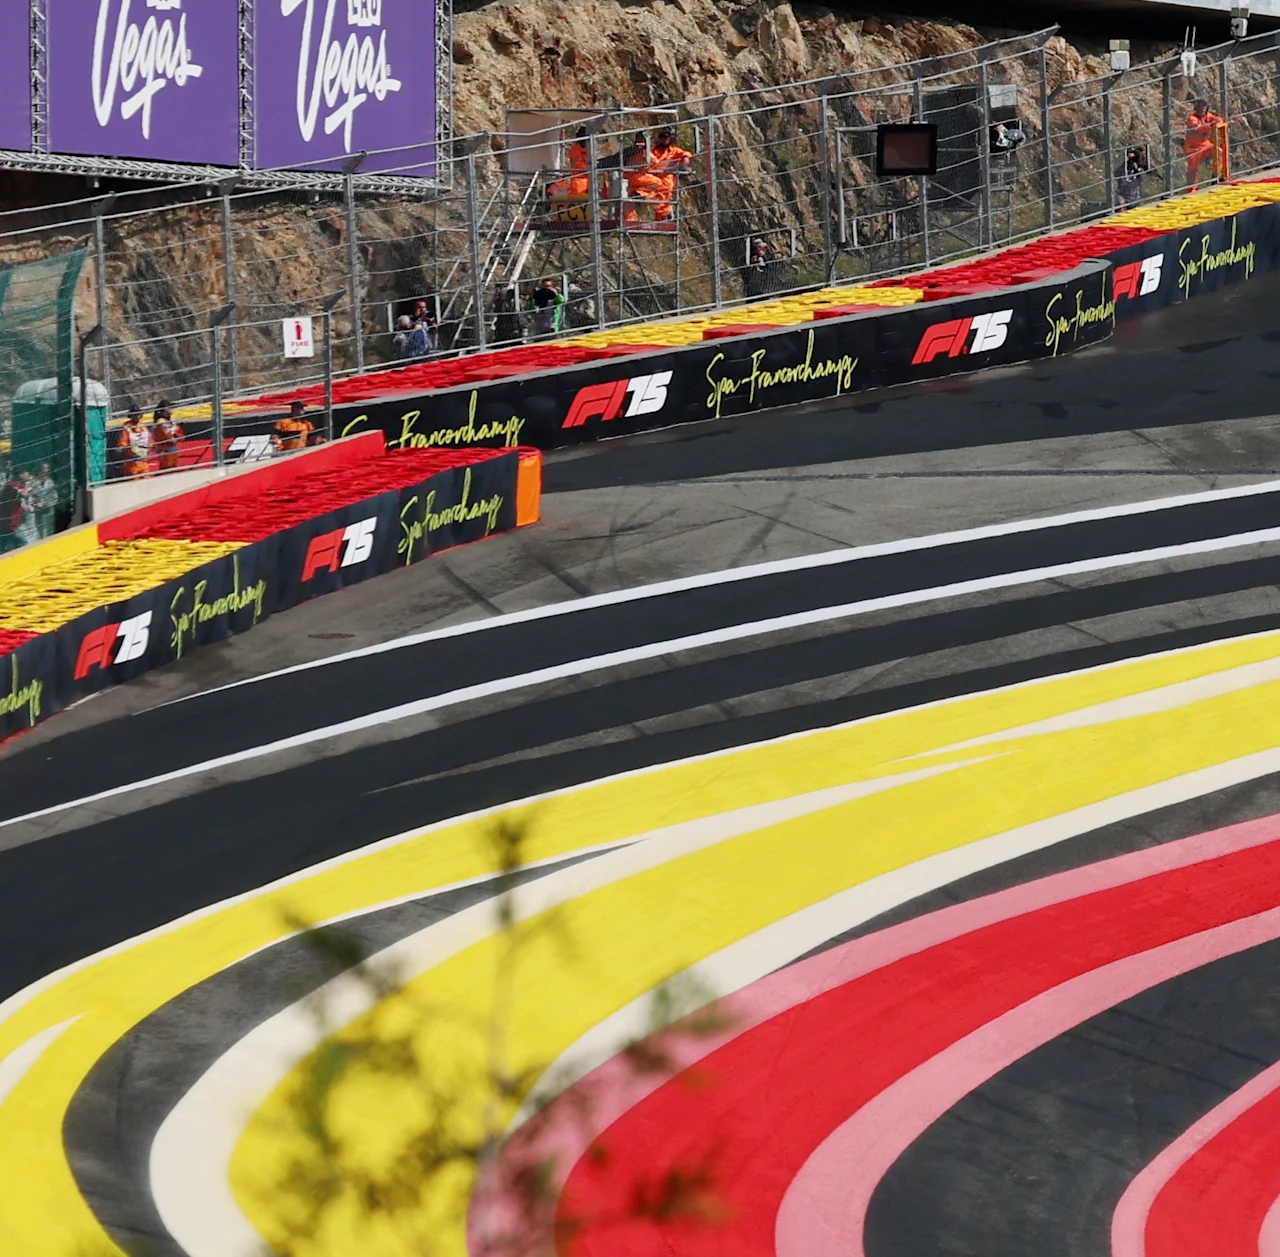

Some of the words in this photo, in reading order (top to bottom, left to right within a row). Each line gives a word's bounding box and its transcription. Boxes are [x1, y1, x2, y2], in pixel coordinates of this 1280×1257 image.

[556, 203, 589, 223] FCY
[1112, 261, 1142, 303] F1
[1139, 253, 1164, 296] 75
[911, 317, 974, 365] F1
[968, 308, 1014, 355] 75
[561, 379, 629, 429] F1
[624, 370, 673, 417] 75
[300, 527, 346, 582] F1
[340, 516, 378, 568] 75
[74, 623, 120, 680] F1
[113, 610, 153, 665] 75
